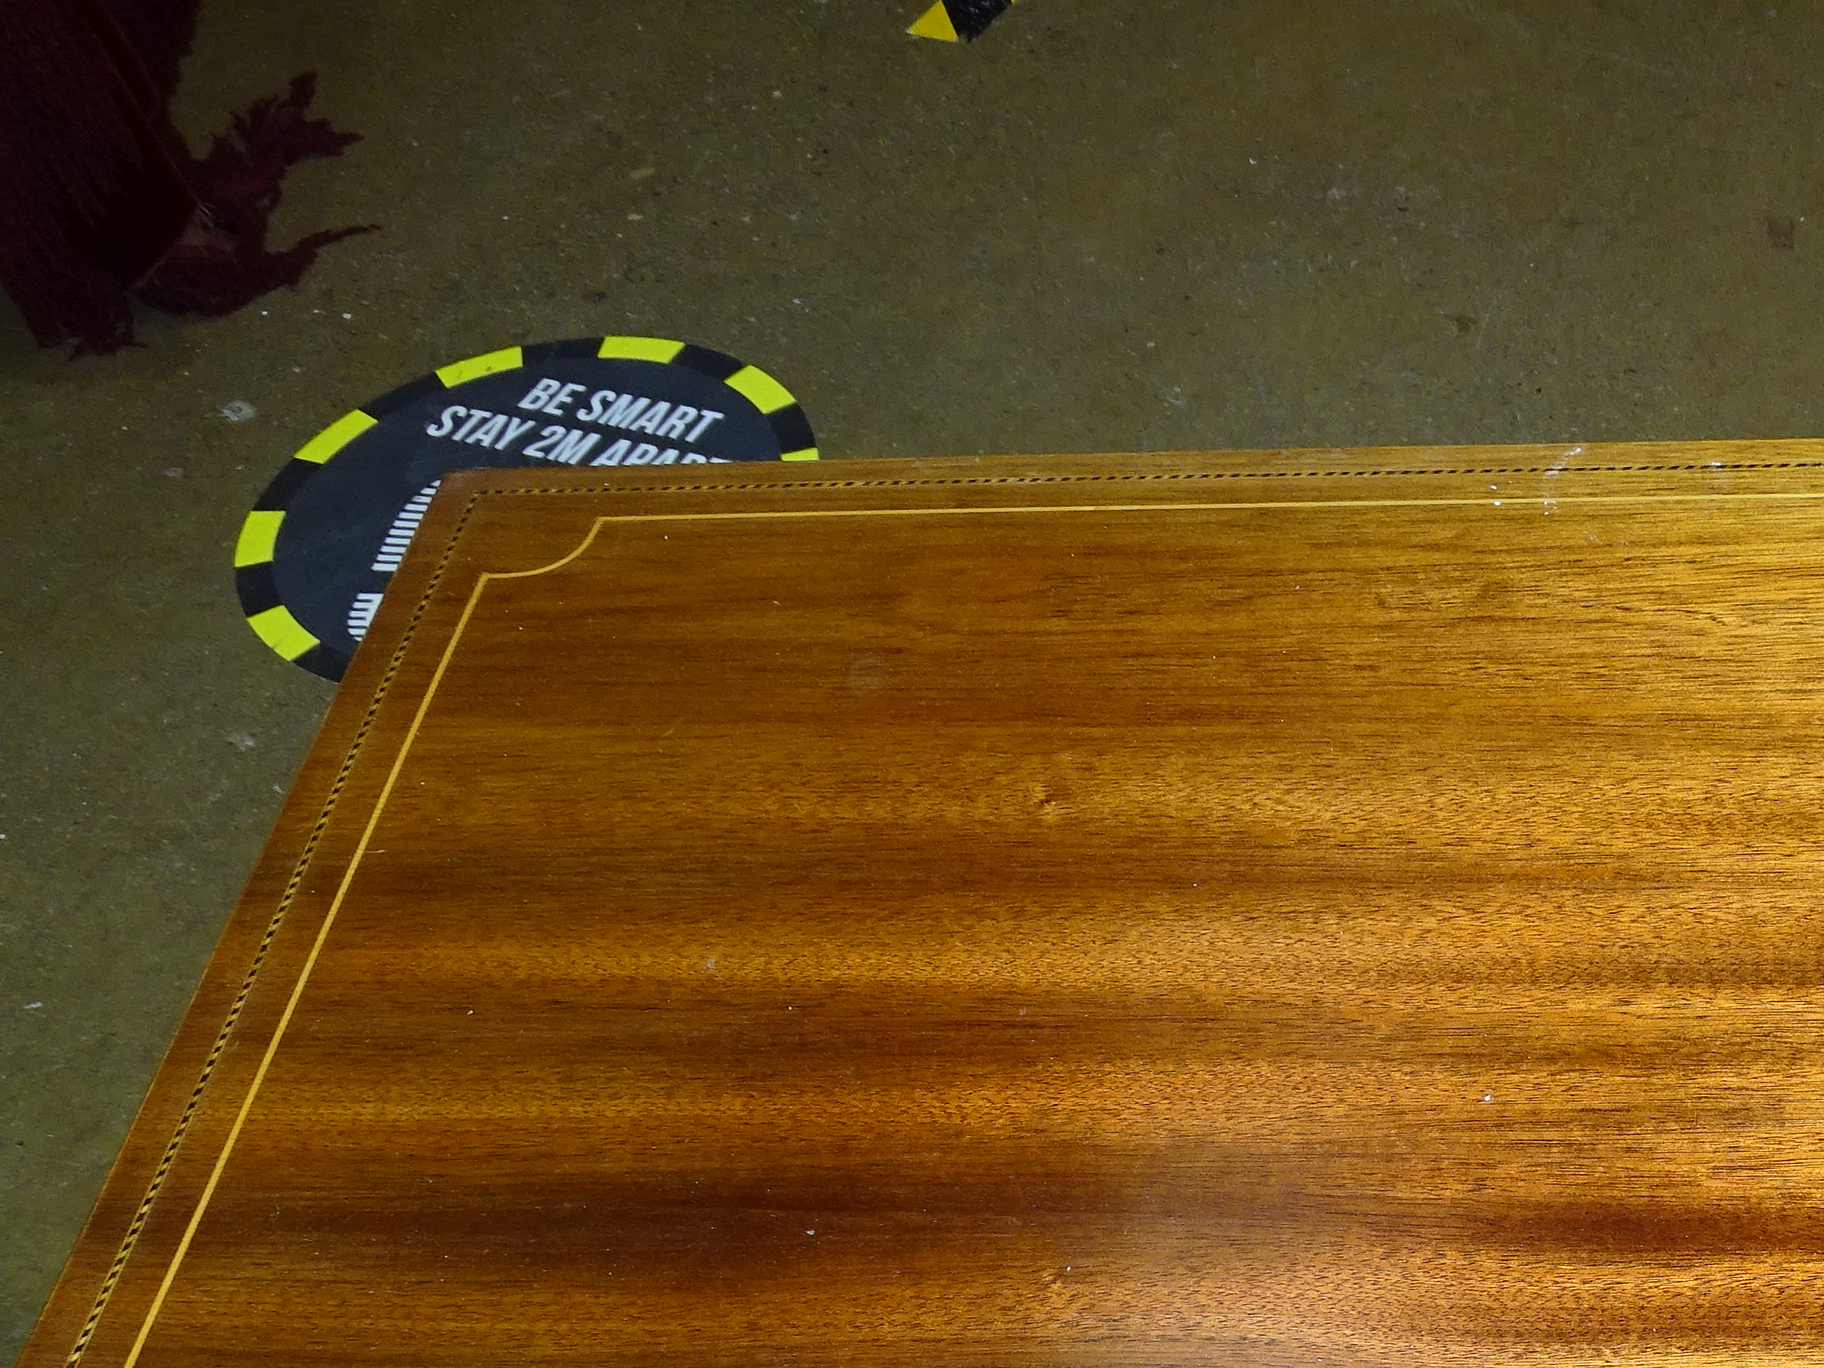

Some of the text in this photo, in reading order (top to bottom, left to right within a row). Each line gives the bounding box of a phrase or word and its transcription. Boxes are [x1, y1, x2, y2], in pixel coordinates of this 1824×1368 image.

[426, 405, 733, 466] STAY 2M APA
[518, 378, 724, 443] BE SMART
